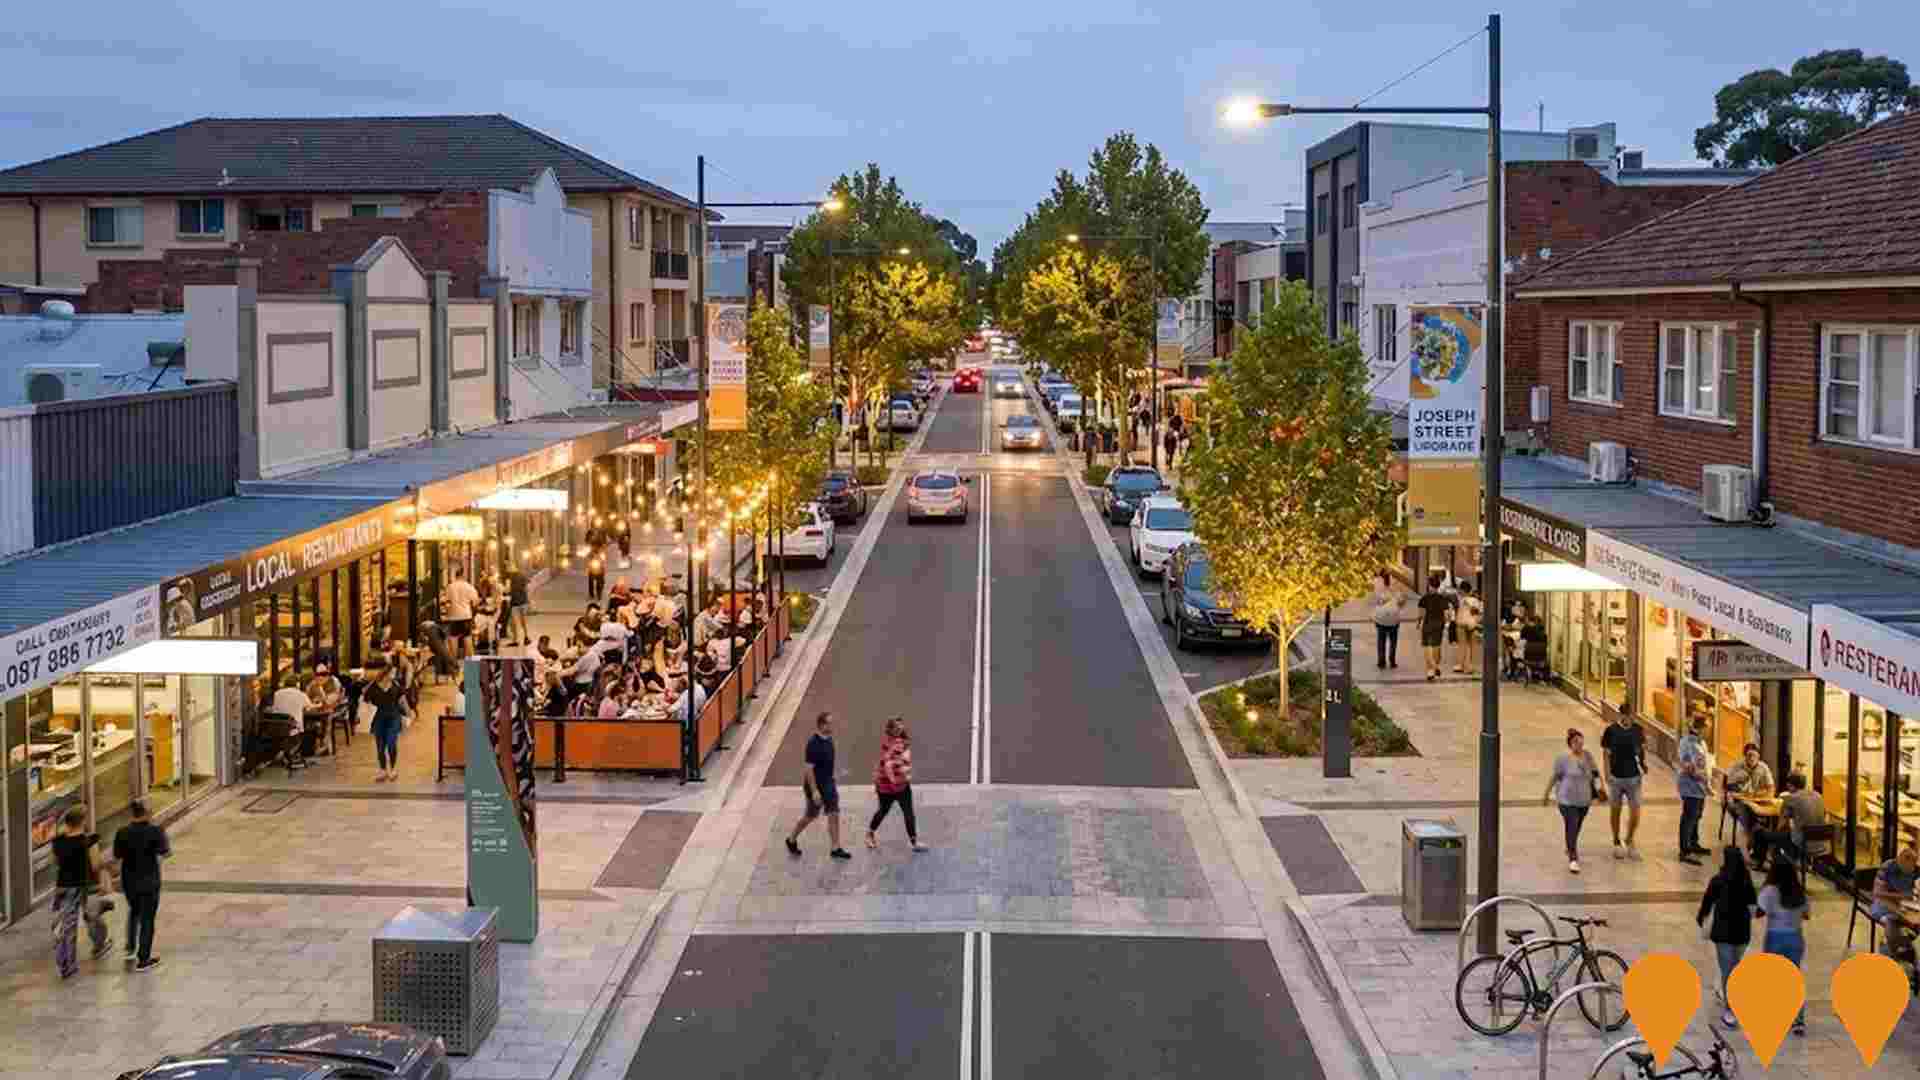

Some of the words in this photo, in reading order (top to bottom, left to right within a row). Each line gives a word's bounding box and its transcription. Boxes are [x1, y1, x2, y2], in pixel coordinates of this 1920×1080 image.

[1415, 409, 1475, 422] JOSEPH
[1415, 425, 1475, 438] STREET
[246, 550, 297, 593] LOCAL
[6, 655, 41, 688] 087
[85, 624, 125, 659] 7732
[16, 634, 46, 656] CALL
